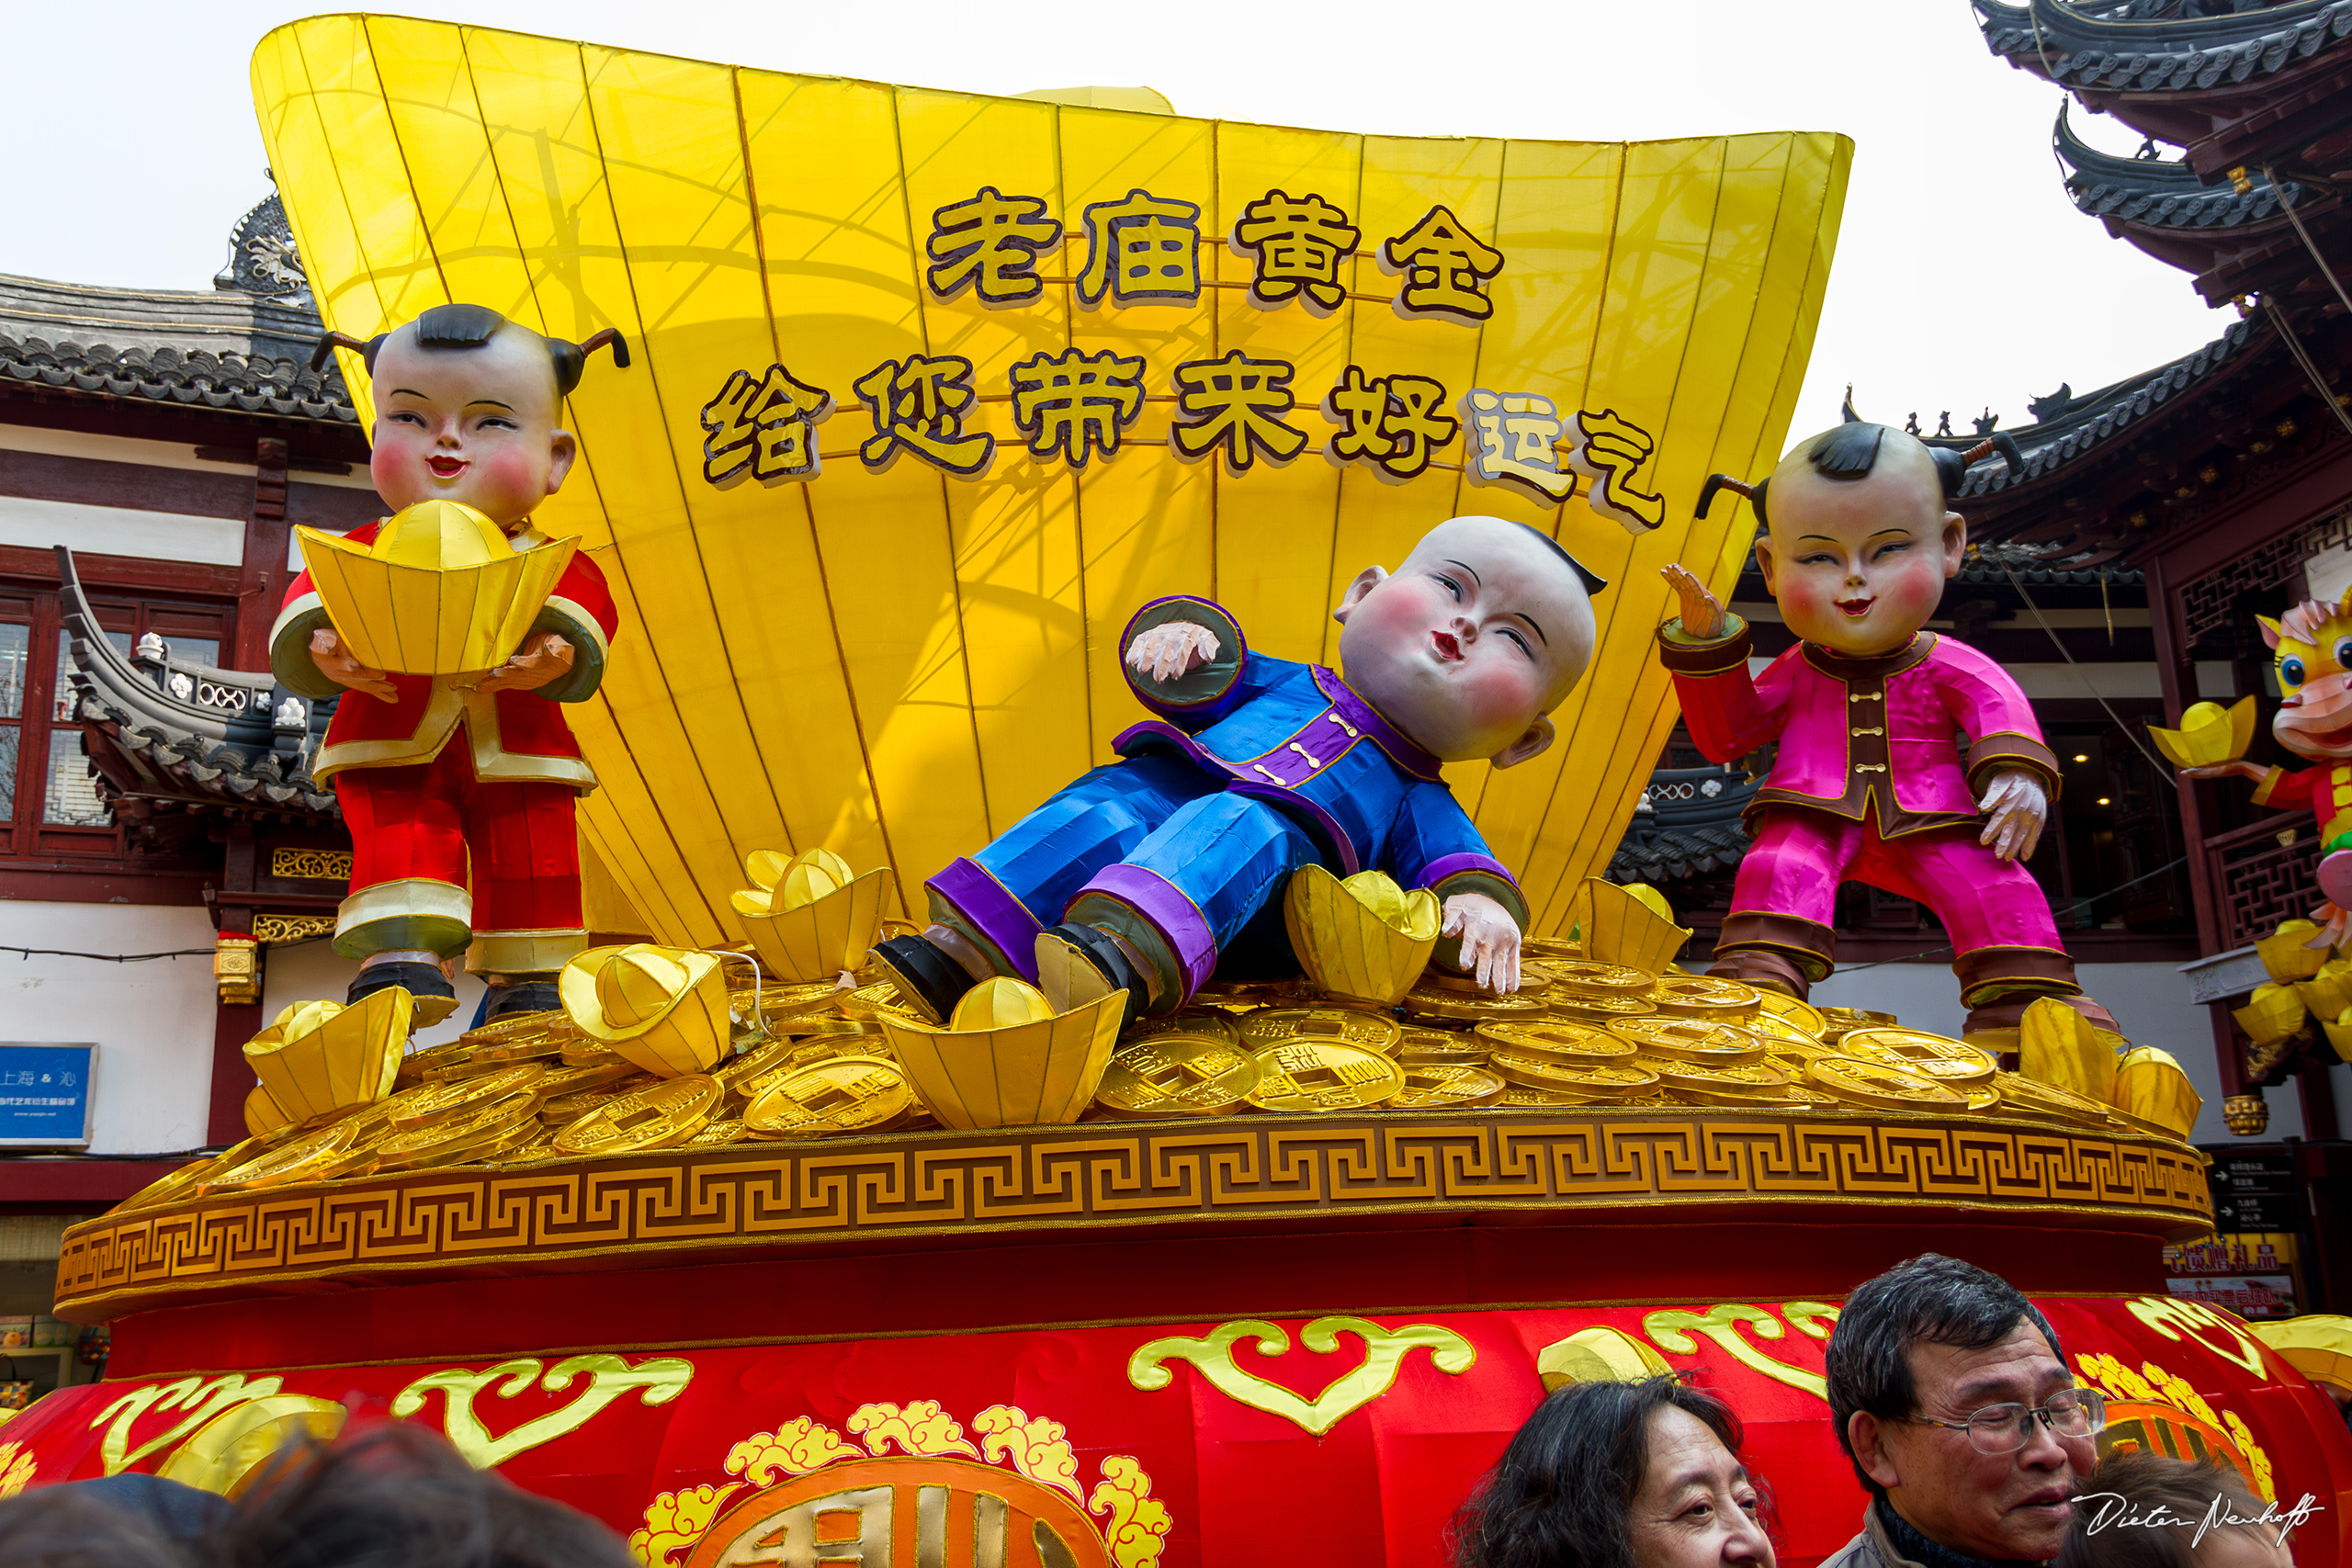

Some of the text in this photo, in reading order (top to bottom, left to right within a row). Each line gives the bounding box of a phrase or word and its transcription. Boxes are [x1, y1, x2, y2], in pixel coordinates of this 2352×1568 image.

[925, 186, 1503, 325] 老庙黄金
[699, 348, 1664, 533] 给您带来好运气
[40, 1073, 52, 1084] &
